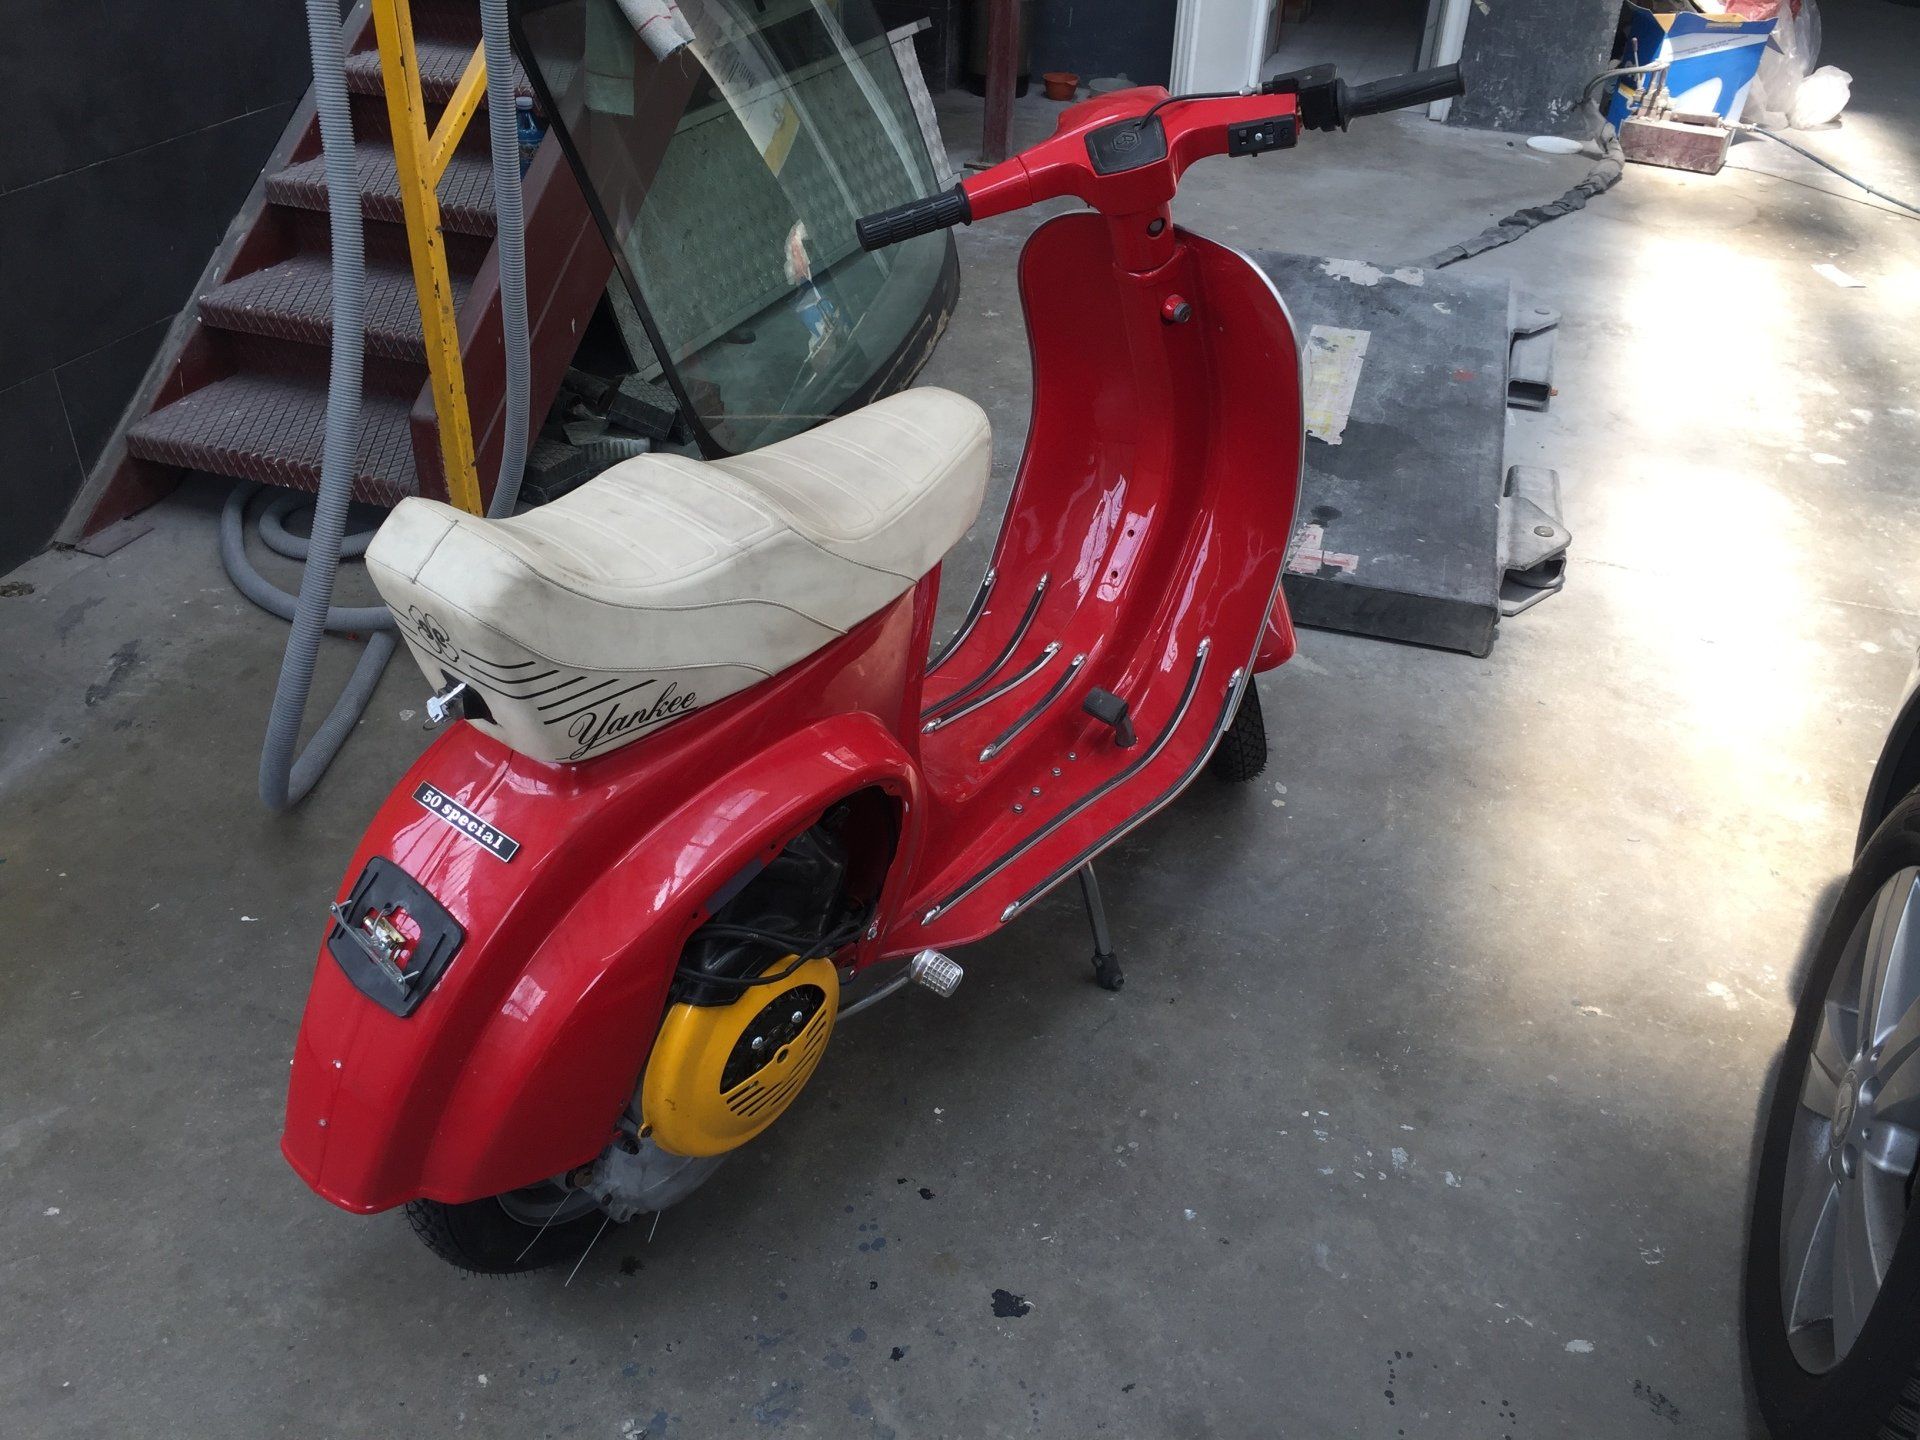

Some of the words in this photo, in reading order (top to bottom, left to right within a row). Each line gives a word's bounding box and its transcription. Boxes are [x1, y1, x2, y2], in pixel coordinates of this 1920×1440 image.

[567, 682, 698, 760] Yankee
[422, 790, 442, 808] 50
[441, 804, 504, 849] special
